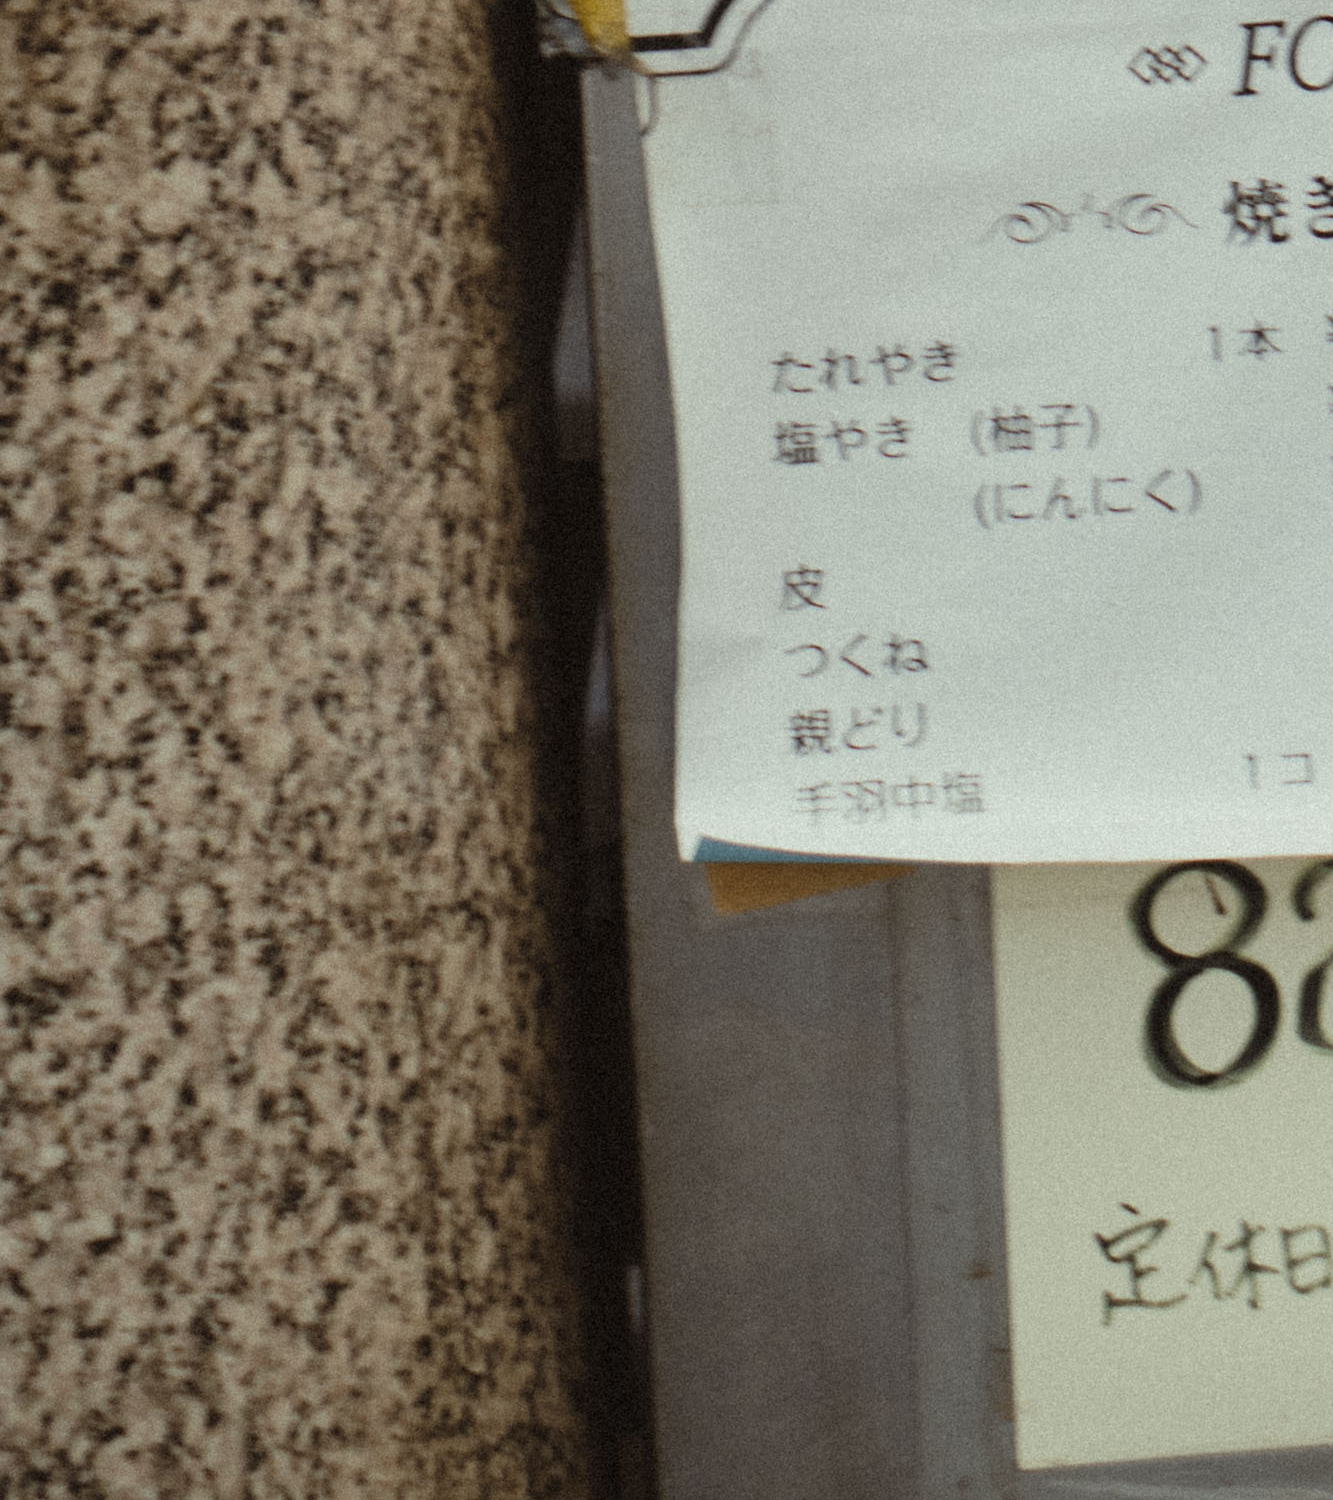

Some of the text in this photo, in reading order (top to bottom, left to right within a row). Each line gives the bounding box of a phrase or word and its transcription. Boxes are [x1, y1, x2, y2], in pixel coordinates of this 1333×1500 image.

[771, 340, 960, 395] たれやき
[1204, 320, 1284, 364] 1本
[772, 416, 914, 466] 塩やき
[969, 403, 1102, 456] (柚子)
[973, 466, 1203, 530] (にんにく)
[778, 563, 828, 613] 皮
[782, 633, 930, 679] つくね
[789, 702, 930, 757] 親どり
[792, 771, 987, 826] 手羽中塩
